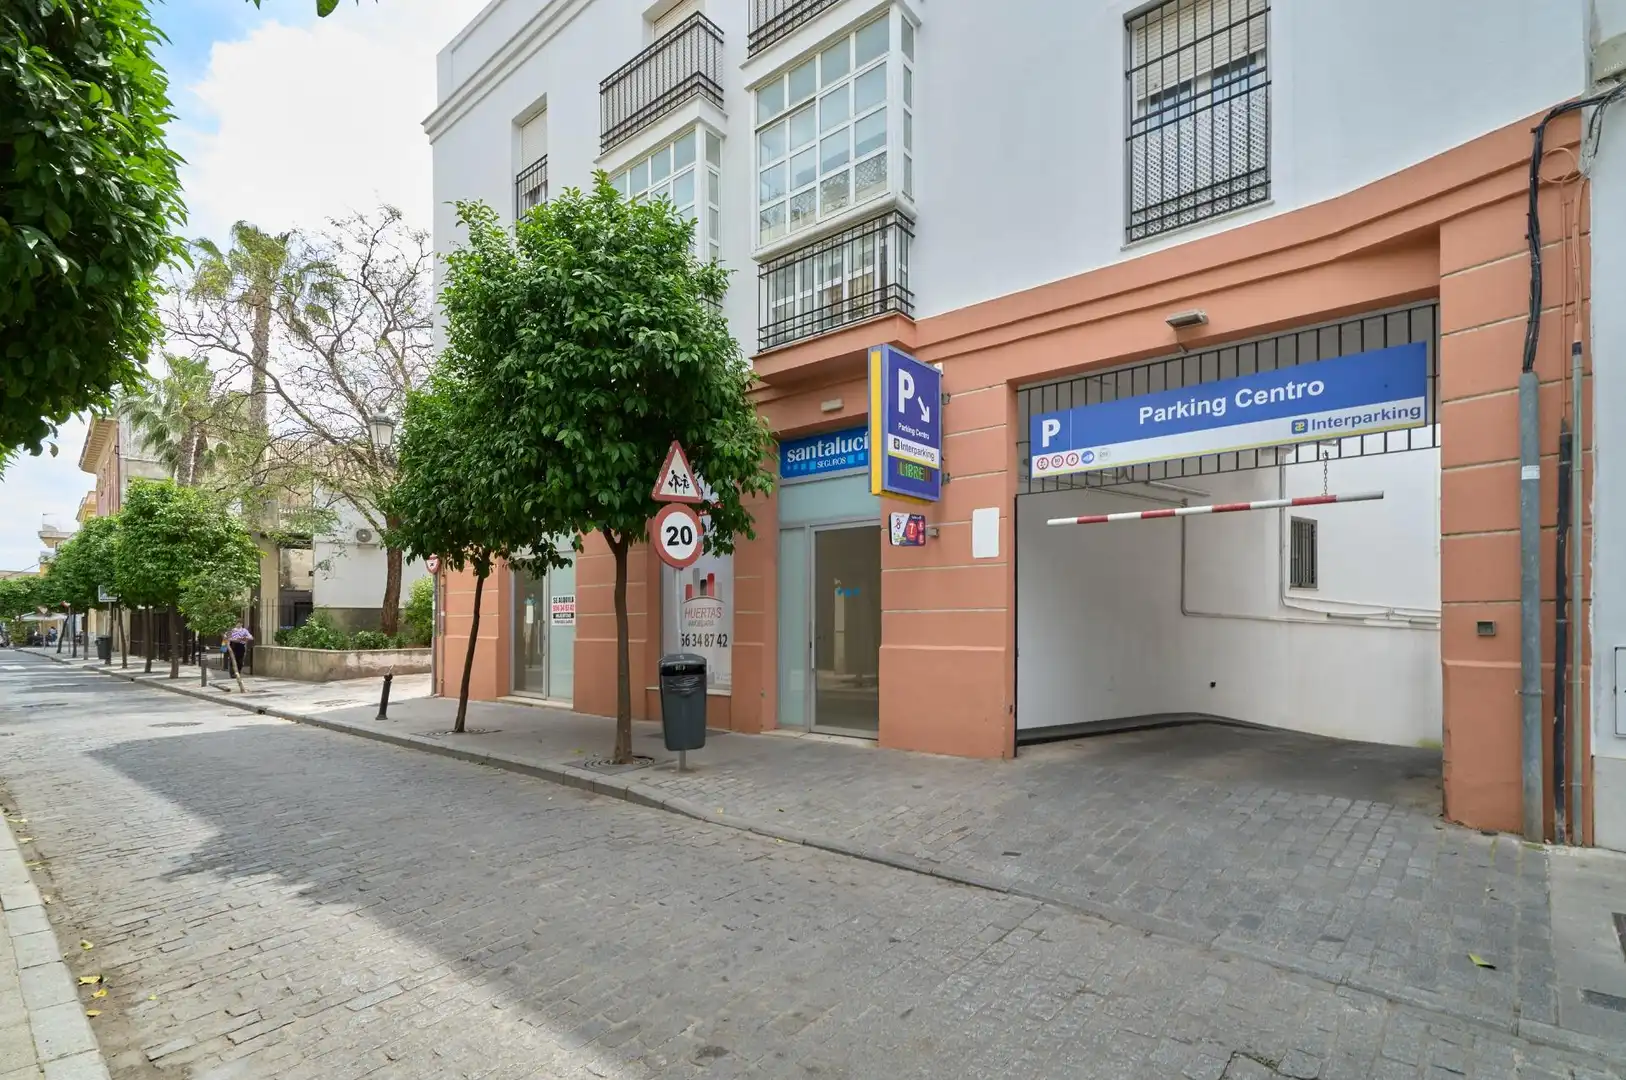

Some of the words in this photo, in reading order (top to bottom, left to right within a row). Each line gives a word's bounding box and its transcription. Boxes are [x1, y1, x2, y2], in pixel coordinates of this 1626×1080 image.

[898, 368, 915, 414] P
[1139, 396, 1227, 425] Parking
[1235, 380, 1325, 408] Centro
[1311, 406, 1422, 431] Interparking
[897, 422, 916, 437] Parking
[915, 428, 930, 440] Centro
[1042, 418, 1061, 448] P
[900, 440, 935, 462] Interparking
[816, 456, 847, 469] SEGUROS
[900, 462, 925, 481] LIBRE
[666, 526, 693, 546] 20
[684, 607, 722, 619] HUERTAS
[692, 633, 703, 648] 34
[704, 633, 715, 648] 87
[716, 633, 728, 648] 42
